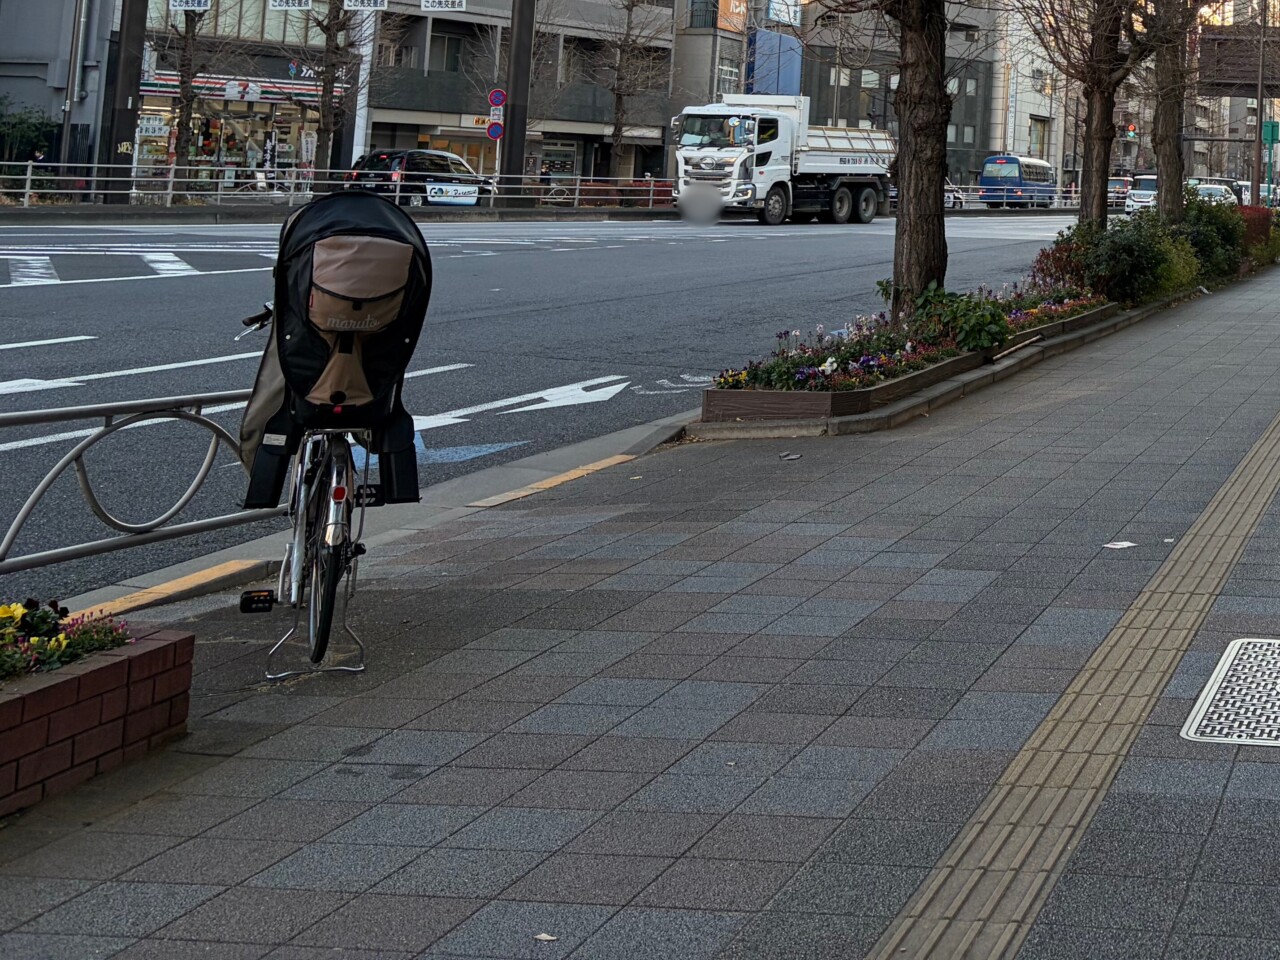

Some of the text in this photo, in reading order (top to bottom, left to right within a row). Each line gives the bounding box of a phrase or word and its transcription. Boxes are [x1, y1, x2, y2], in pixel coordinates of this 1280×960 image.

[171, 0, 209, 8] この先交差点
[271, 0, 310, 8] この先交差点
[346, 0, 386, 8] この先交差点
[423, 0, 464, 9] この先交差点
